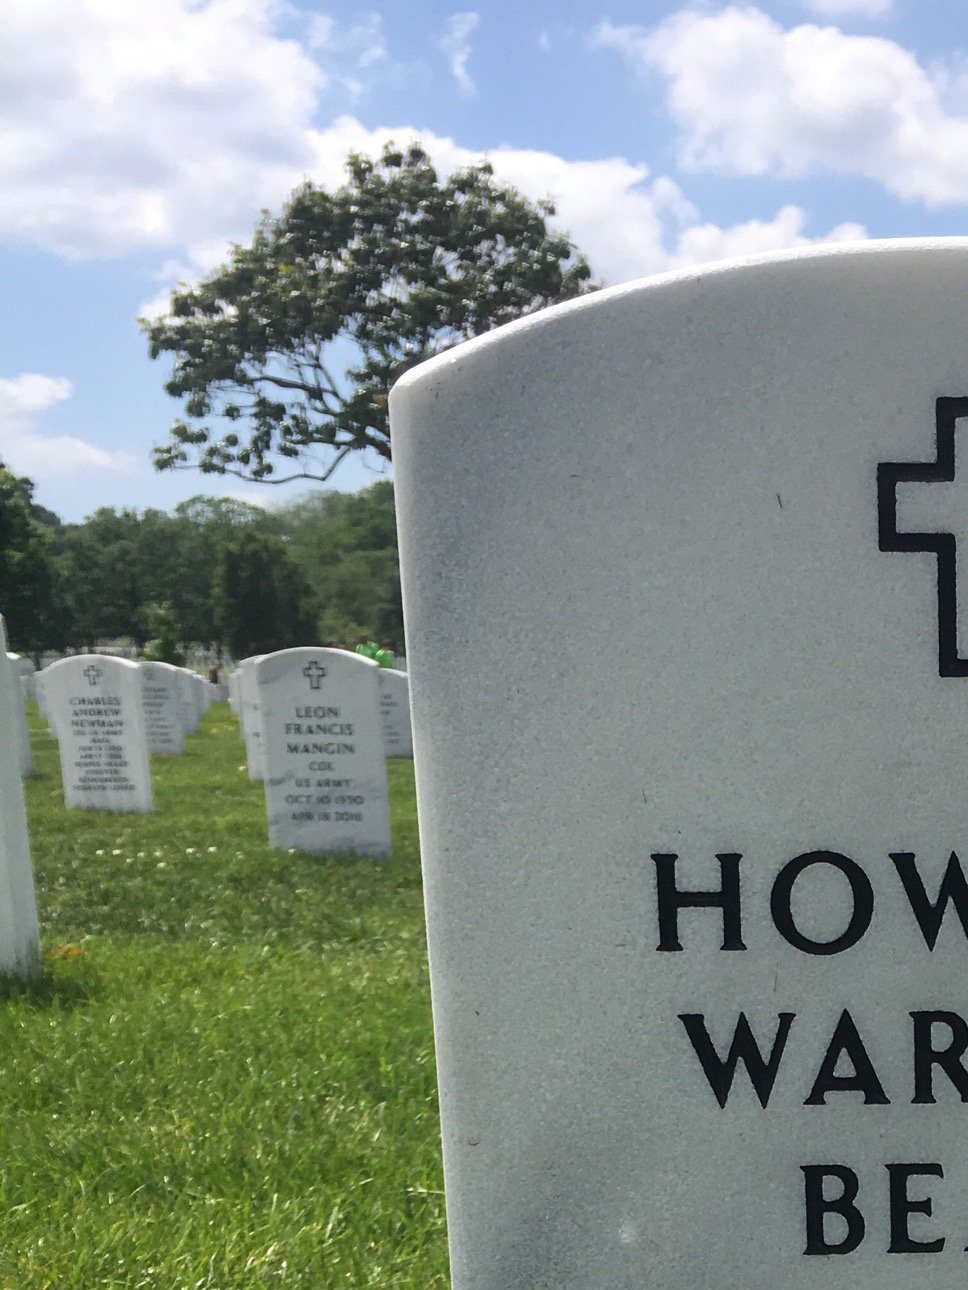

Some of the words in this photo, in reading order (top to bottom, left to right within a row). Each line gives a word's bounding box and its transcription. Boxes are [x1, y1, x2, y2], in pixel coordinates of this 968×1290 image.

[71, 708, 121, 717] ANDREW
[296, 706, 339, 719] LEON
[71, 719, 124, 727] NEWMAN
[285, 723, 354, 736] FRANCIS
[286, 743, 355, 754] MANGIN
[308, 761, 335, 771] COL
[295, 779, 310, 788] US
[315, 778, 351, 788] ARMY
[285, 795, 312, 804] OCT
[291, 812, 313, 821] APR
